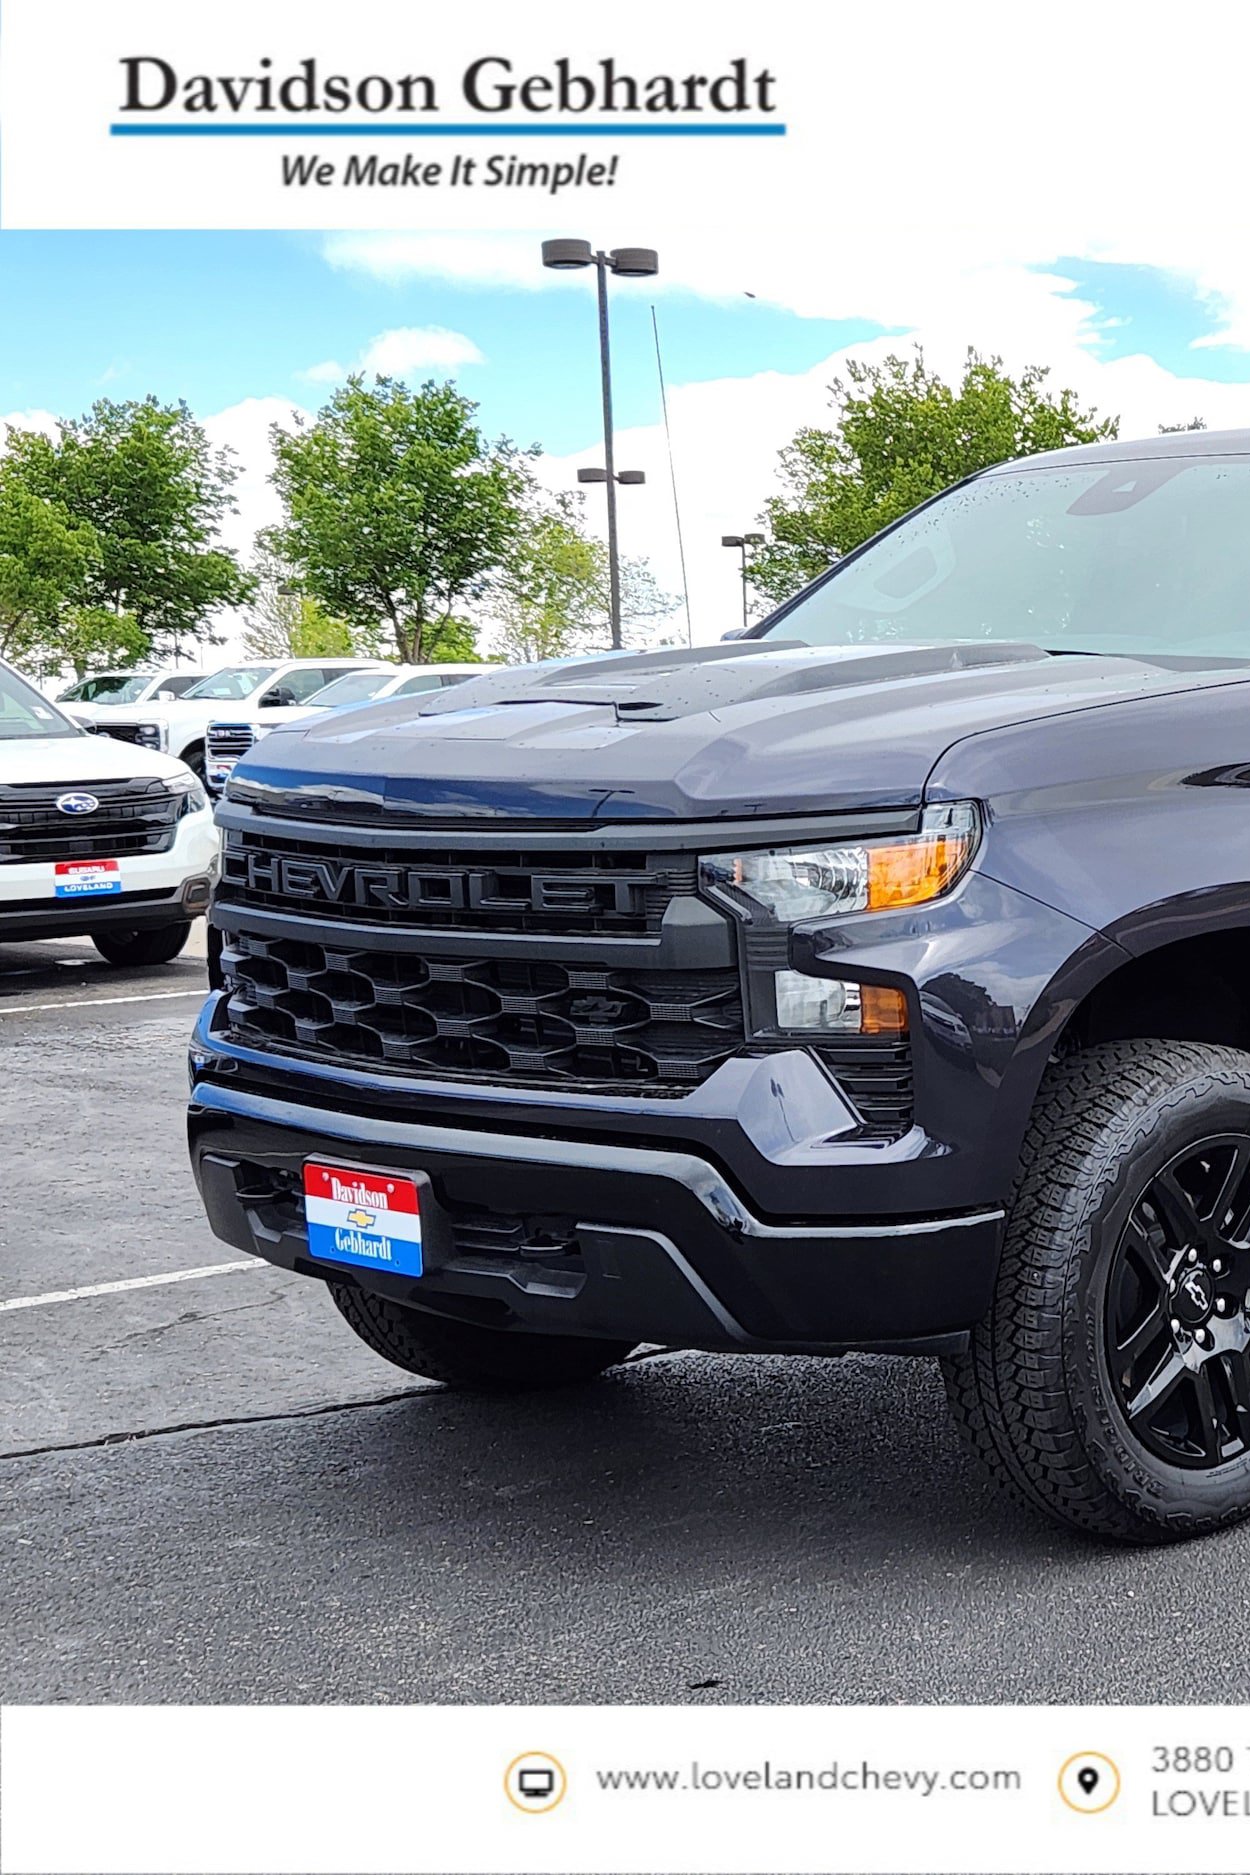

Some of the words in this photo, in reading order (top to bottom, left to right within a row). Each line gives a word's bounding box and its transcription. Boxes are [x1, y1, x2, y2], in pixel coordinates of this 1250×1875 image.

[68, 866, 106, 875] SUBARU
[220, 850, 668, 915] CHEVROLET
[64, 882, 114, 893] LOVELAND
[330, 1177, 389, 1210] Davidson
[335, 1227, 392, 1261] Gebhardt
